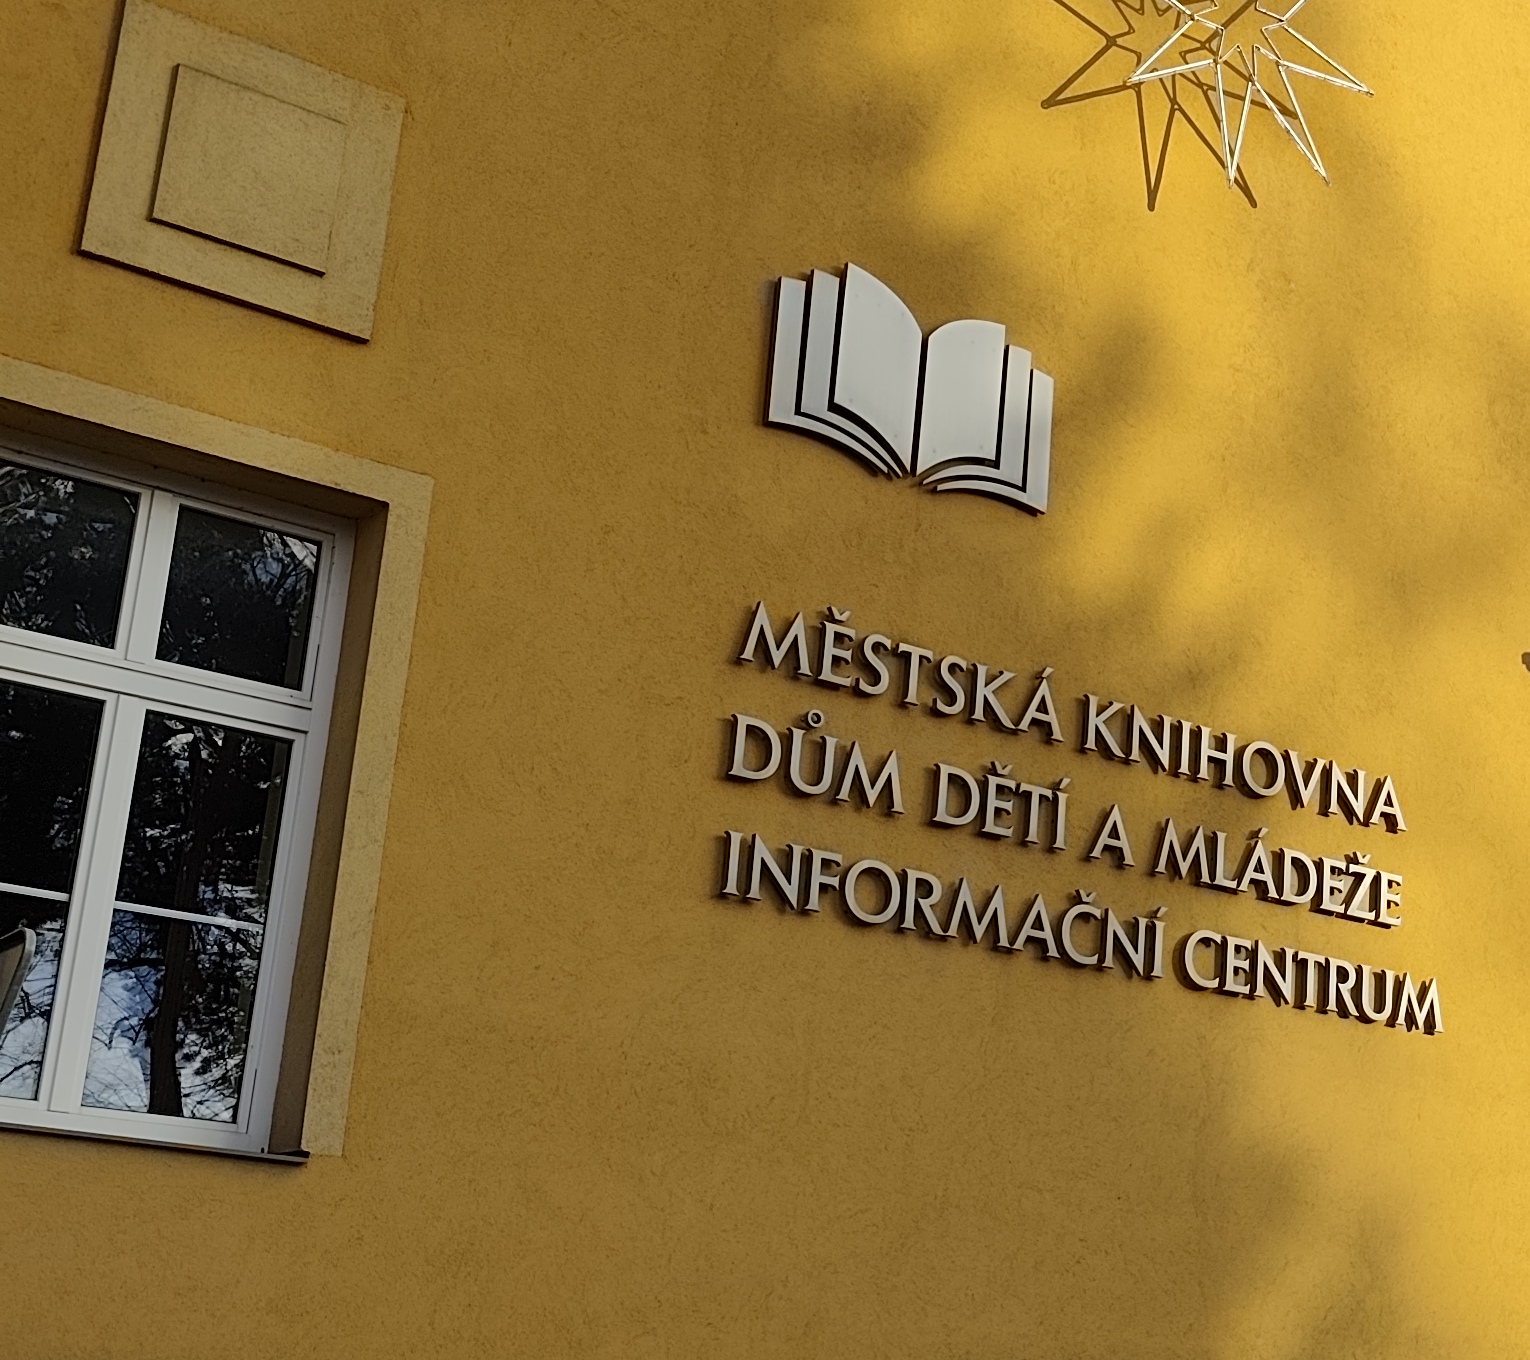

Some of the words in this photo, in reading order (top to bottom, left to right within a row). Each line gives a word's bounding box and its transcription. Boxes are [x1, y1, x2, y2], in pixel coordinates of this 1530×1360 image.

[727, 709, 905, 815] DŮM
[932, 761, 1071, 851] DĚTÍ
[1088, 804, 1135, 868] A
[1153, 817, 1405, 928] MLÁDEŽE
[738, 601, 1064, 743] MĚSTSKÁ
[1082, 693, 1409, 833] KNIHOVNA
[720, 830, 1166, 980] INFORMAČNÍ
[1183, 929, 1445, 1035] CENTRUM
